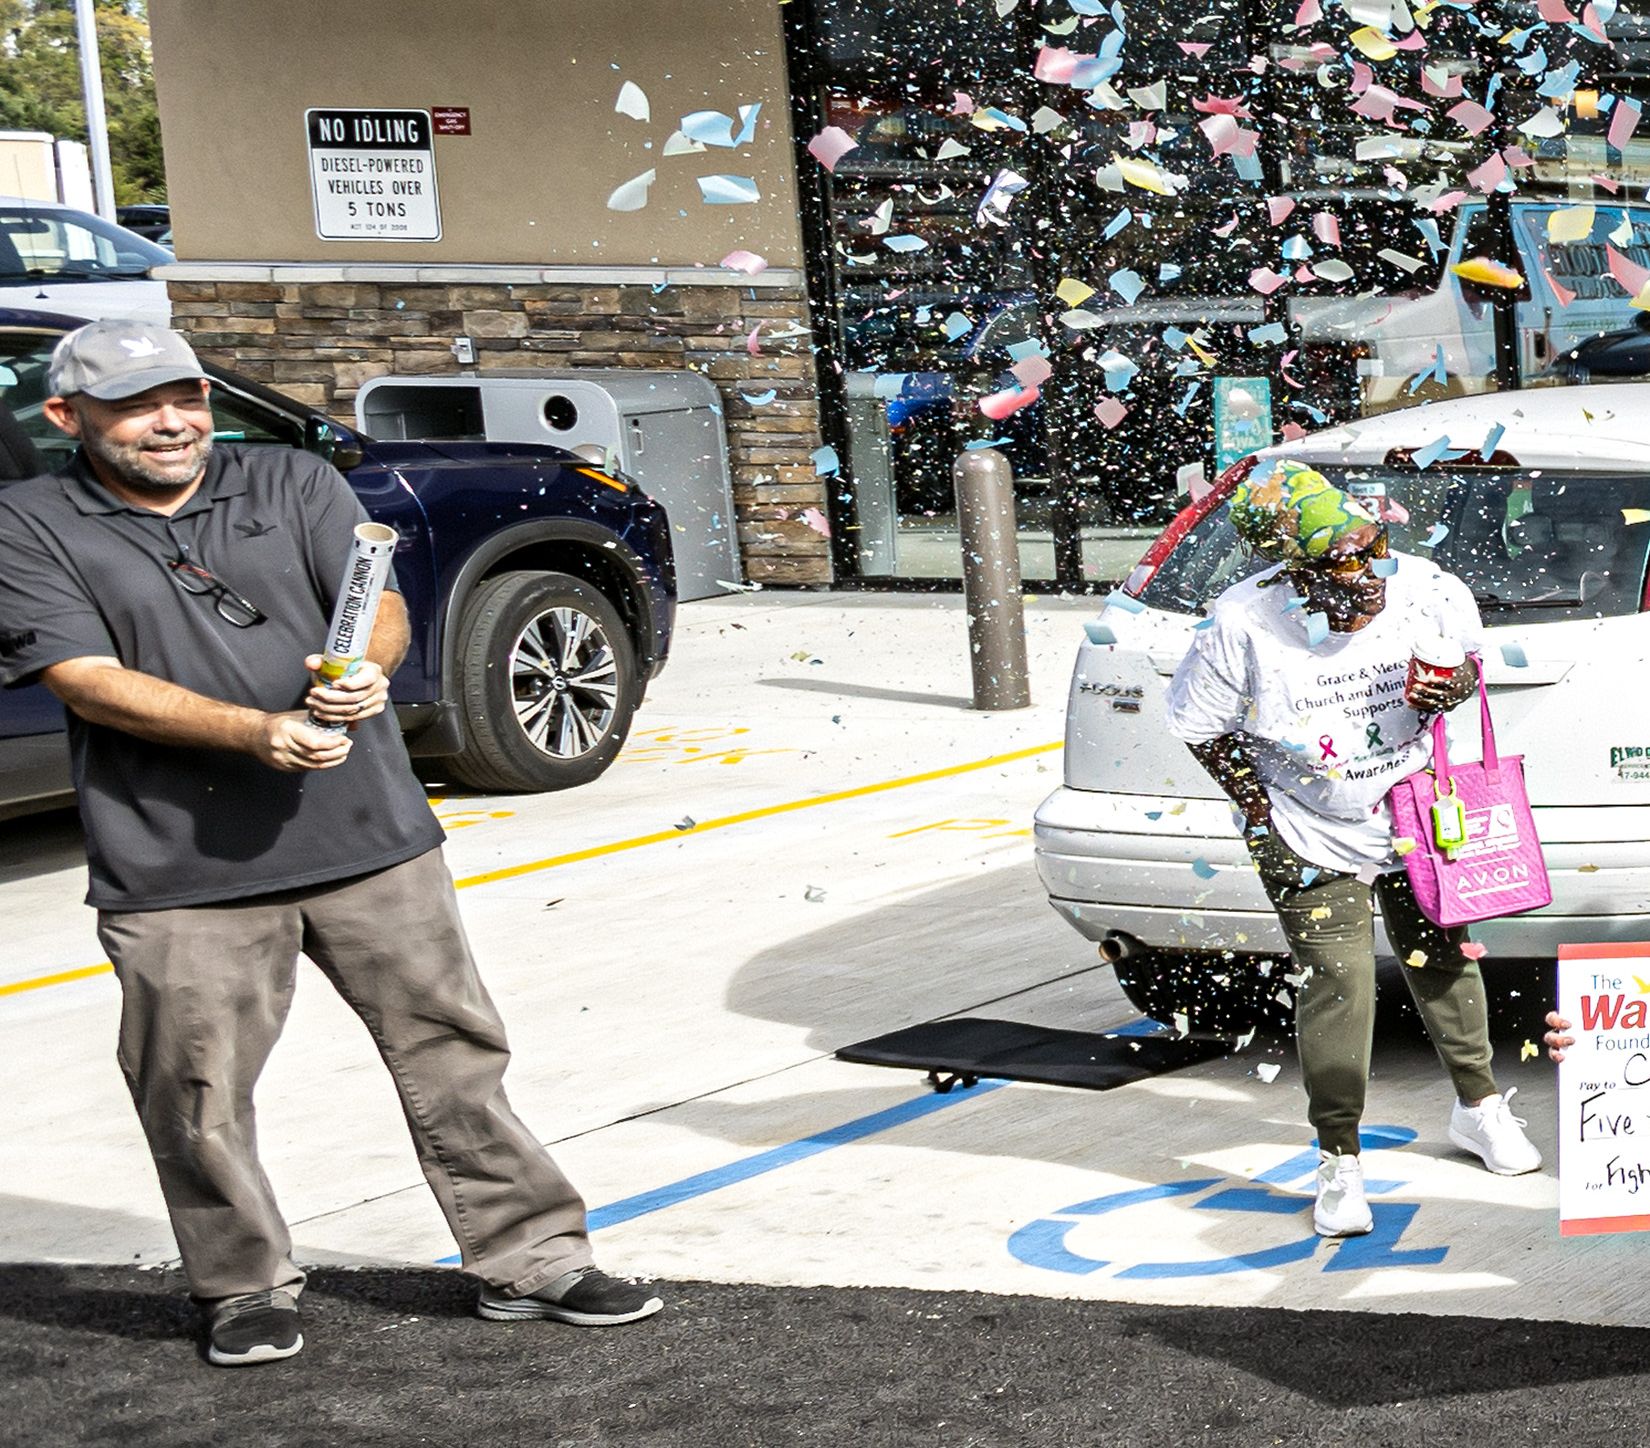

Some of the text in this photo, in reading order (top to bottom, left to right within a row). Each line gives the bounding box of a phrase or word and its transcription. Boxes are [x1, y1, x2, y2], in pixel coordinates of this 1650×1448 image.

[319, 118, 419, 143] NO IDLING
[321, 157, 424, 174] DIESEL-POWERED
[328, 179, 422, 196] VEHICLES OVER
[348, 201, 407, 217] 5 TONS
[333, 556, 373, 654] CELEBRATION CANNON
[1316, 669, 1370, 688] Grace &
[1295, 678, 1406, 713] Church and Mini
[1343, 698, 1404, 720] Supports
[1457, 863, 1529, 891] AVON
[1591, 974, 1622, 991] The
[1579, 1080, 1617, 1092] Pay to
[1580, 1091, 1635, 1142] Five
[1584, 1181, 1603, 1192] For
